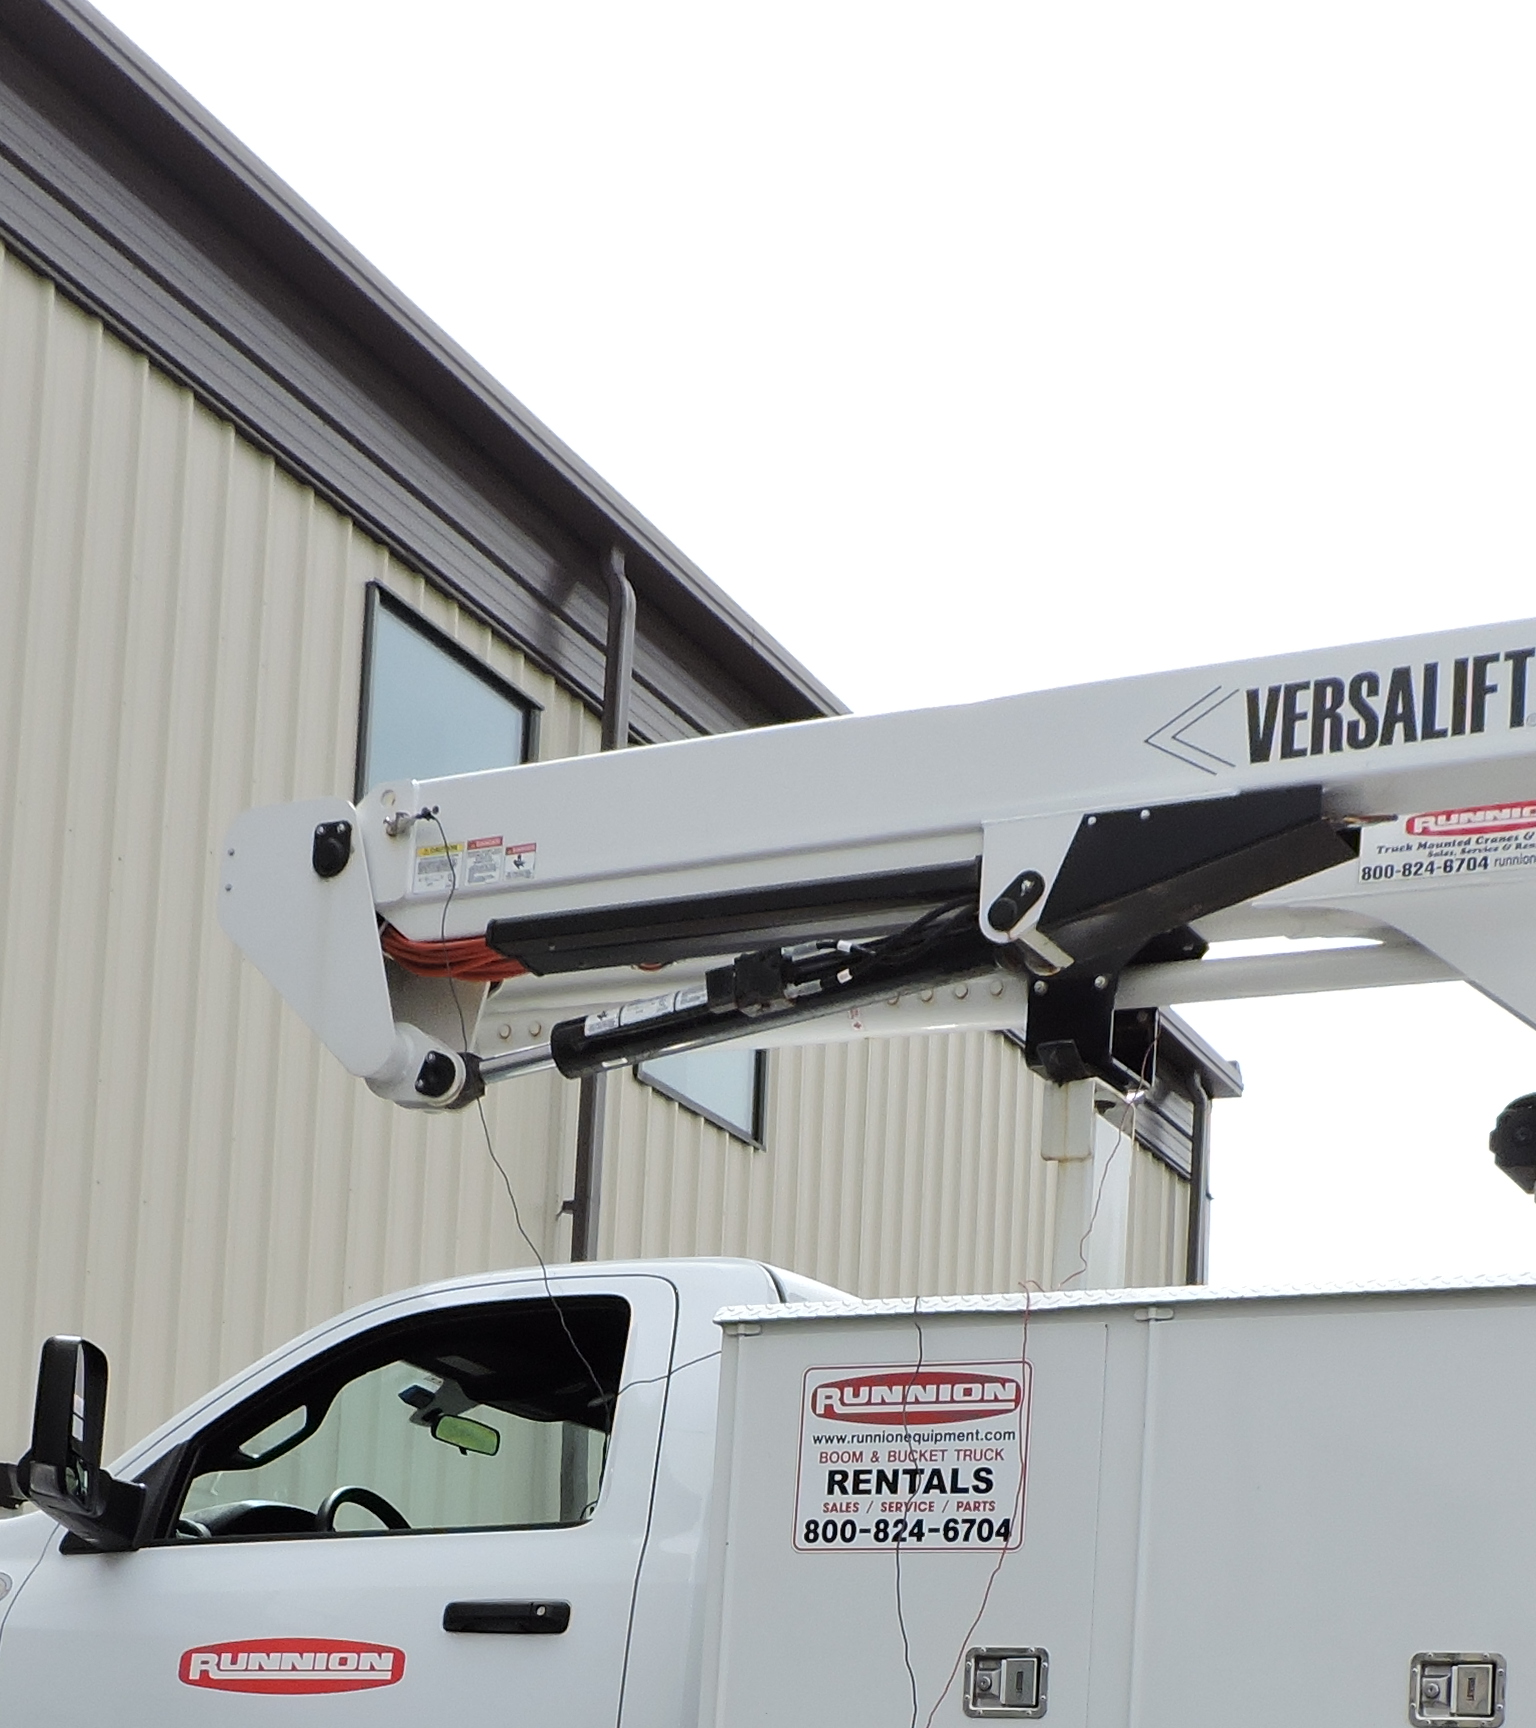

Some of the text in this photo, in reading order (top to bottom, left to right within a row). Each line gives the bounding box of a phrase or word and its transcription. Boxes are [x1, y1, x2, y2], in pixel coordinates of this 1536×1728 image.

[1245, 647, 1536, 764] VERSALIFT
[1377, 842, 1414, 855] Truck
[1416, 837, 1472, 851] Mounted
[1475, 833, 1520, 846] Cranes
[1459, 844, 1500, 855] Service
[1361, 855, 1490, 881] 800-824-6704
[816, 1382, 1017, 1414] RUNNION
[813, 1429, 1016, 1446] www.runnionequipment.com
[819, 1448, 1005, 1464] BOOM & BUCKET TRUCK
[826, 1467, 994, 1496] RENTALS
[822, 1501, 860, 1514] SALES
[880, 1501, 935, 1514] SERVICE
[956, 1500, 996, 1513] PARTS
[803, 1518, 1012, 1544] 800-824-6704
[188, 1652, 395, 1680] RUNNION
